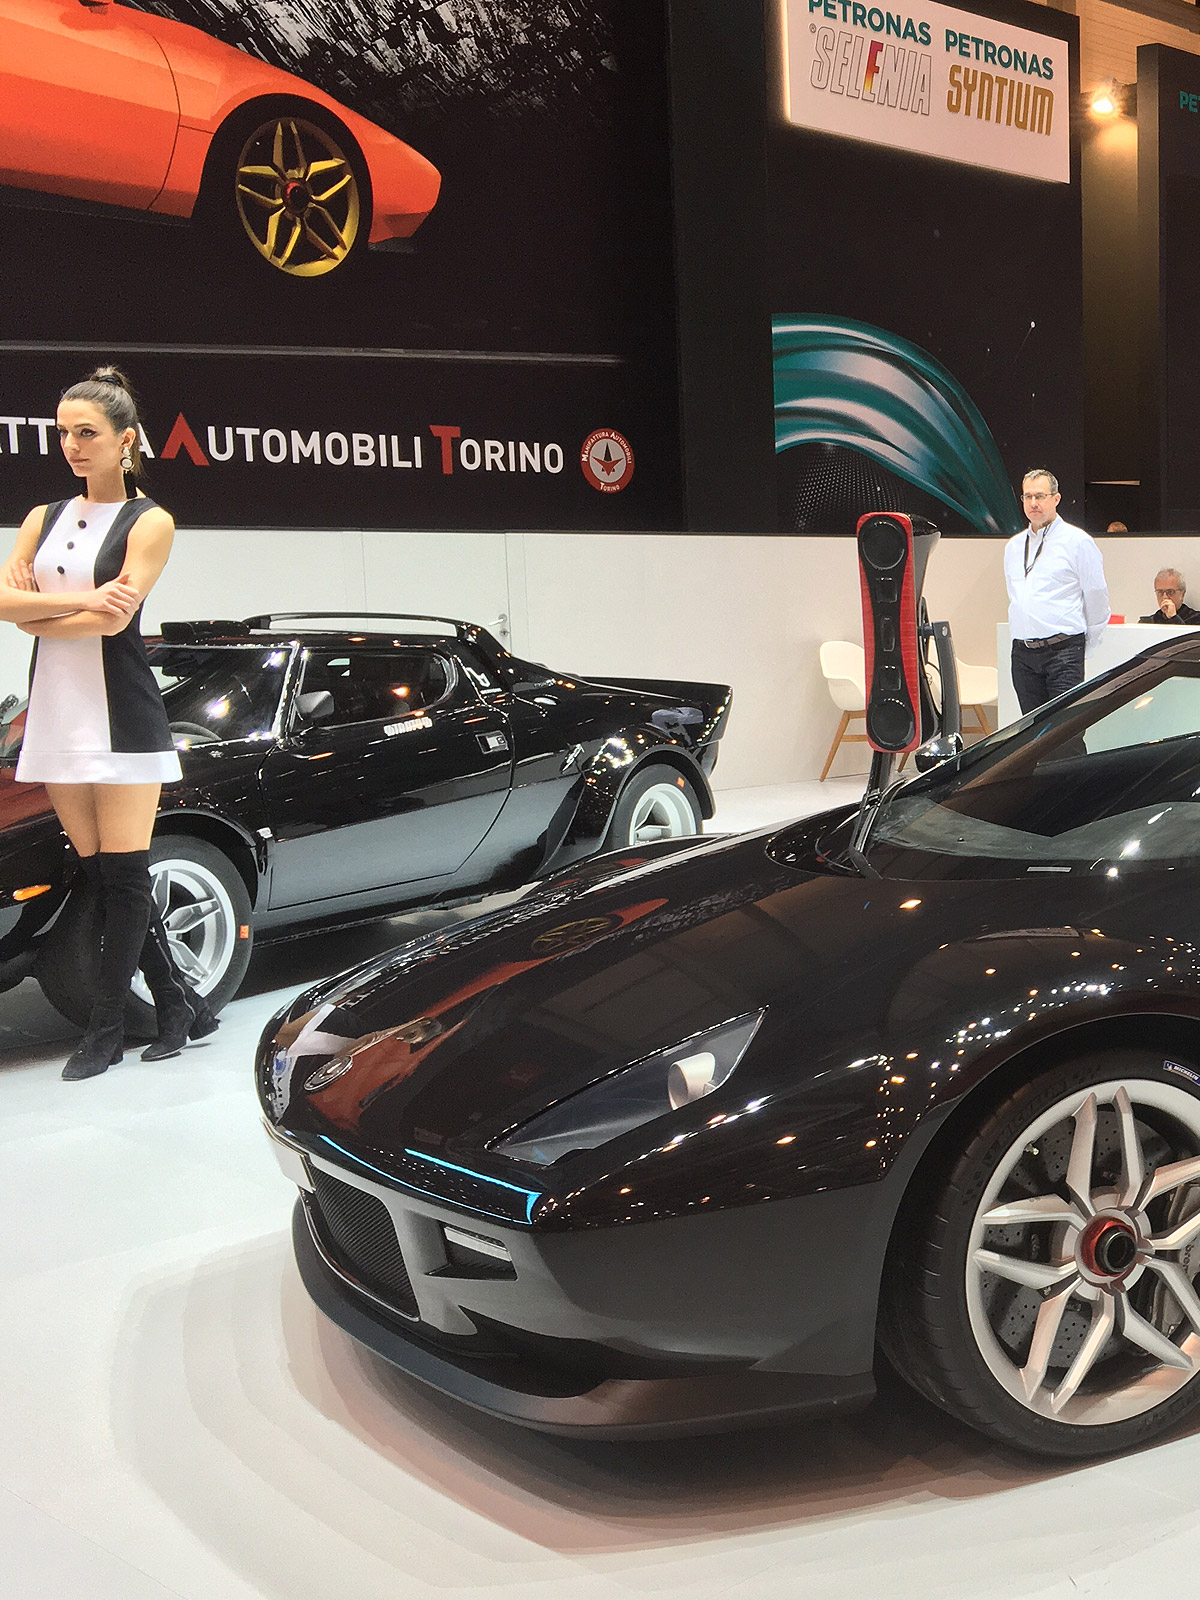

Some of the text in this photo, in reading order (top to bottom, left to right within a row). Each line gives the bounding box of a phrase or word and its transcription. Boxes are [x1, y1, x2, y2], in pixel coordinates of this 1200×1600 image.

[808, 0, 931, 46] PETRONAS
[810, 26, 932, 116] SELENIA
[945, 29, 1054, 80] PETRONAS
[947, 64, 1054, 137] SYNTIUM
[160, 412, 422, 469] AUTOMOBILI
[429, 425, 564, 475] TORINO
[600, 482, 620, 492] TORINO
[1173, 1065, 1199, 1081] MICHELIN
